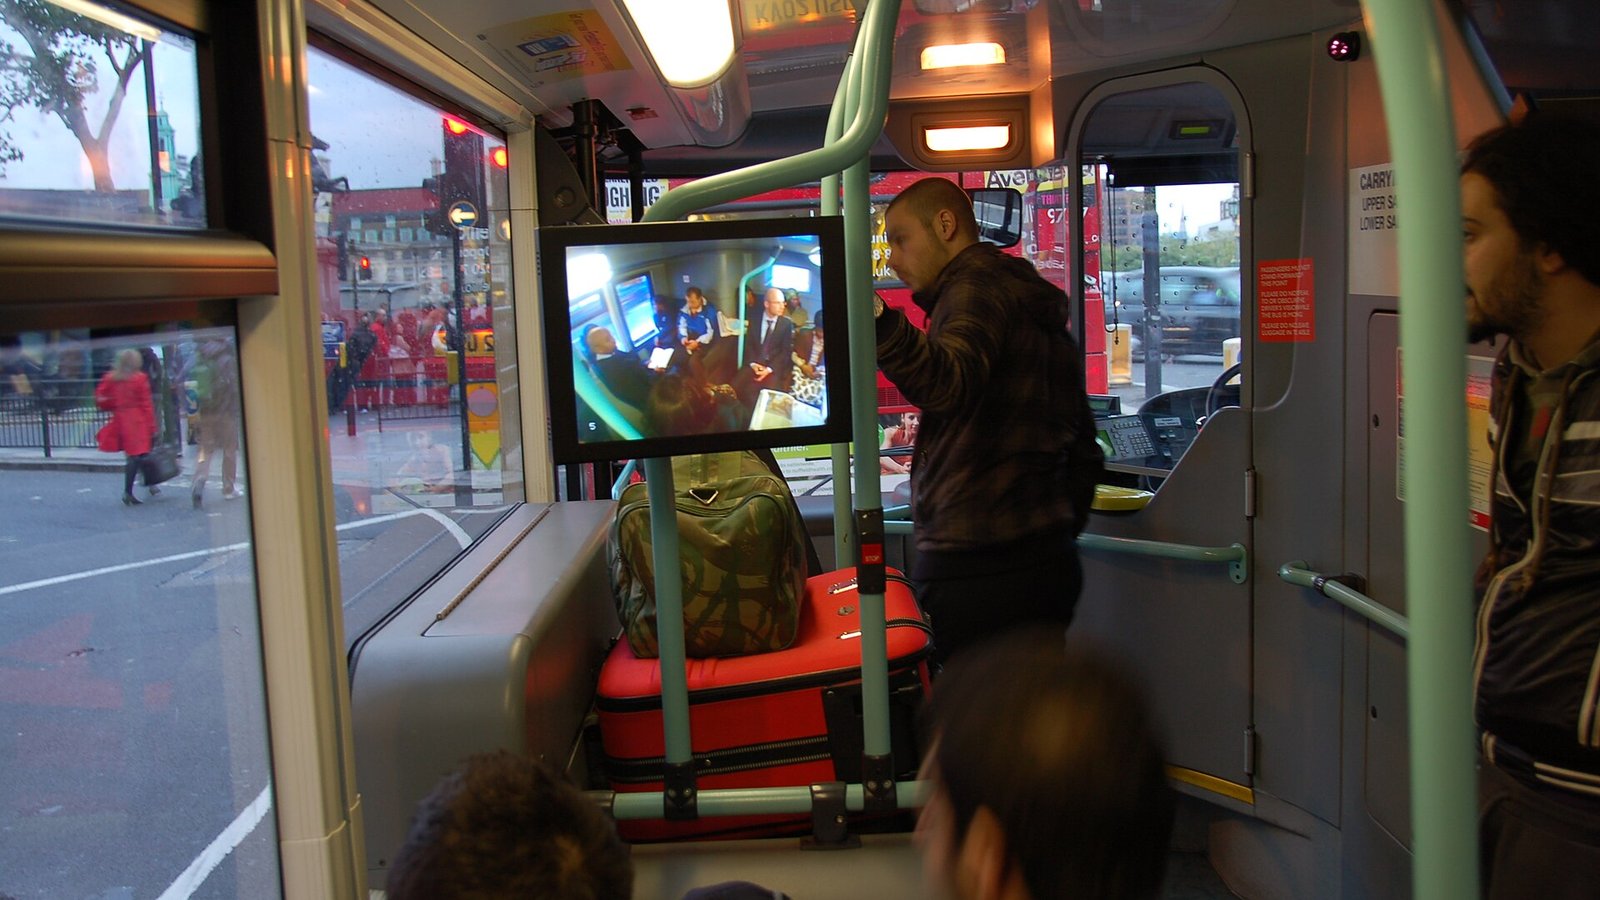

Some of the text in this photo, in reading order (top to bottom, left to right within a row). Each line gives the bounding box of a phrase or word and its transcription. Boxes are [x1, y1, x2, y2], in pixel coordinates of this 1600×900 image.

[1362, 196, 1385, 211] UPPER
[1360, 216, 1384, 230] LOWER
[589, 422, 596, 430] 5
